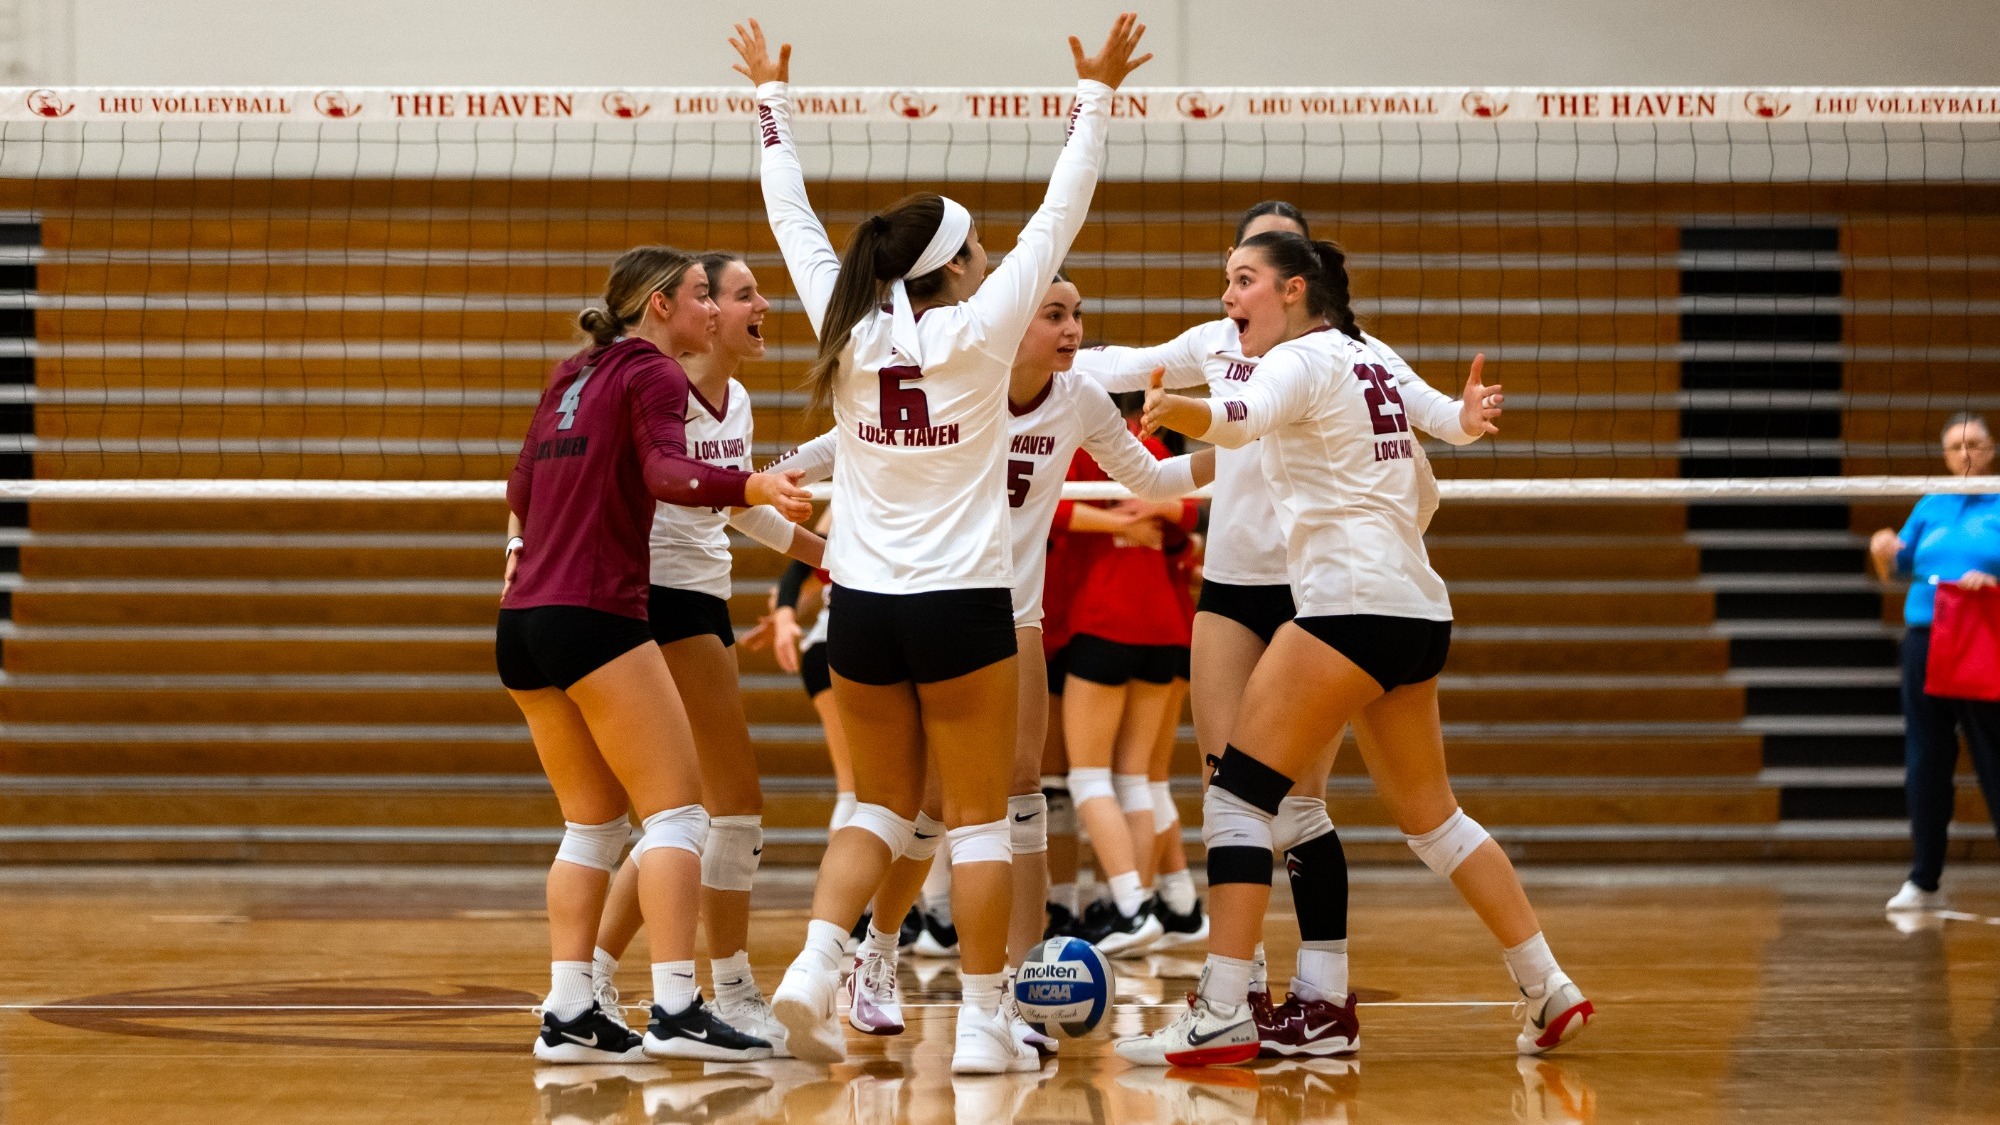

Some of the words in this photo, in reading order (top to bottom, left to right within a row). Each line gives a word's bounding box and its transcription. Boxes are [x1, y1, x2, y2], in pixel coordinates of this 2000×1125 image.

[99, 96, 143, 113] LHU
[152, 96, 291, 113] VOLLEYBALL
[391, 94, 455, 117] THE
[466, 93, 573, 117] HAVEN
[674, 97, 718, 114] LHU
[727, 97, 866, 114] VOYBALL
[965, 94, 1029, 117] THE
[1041, 94, 1148, 118] HEN
[1248, 97, 1292, 115] LHU
[1300, 97, 1438, 114] VOLLEYBALL
[1536, 93, 1599, 117] THE
[1610, 93, 1716, 117] HAVEN
[1814, 96, 1859, 114] LHU
[1865, 96, 2000, 114] VOLLEYBALL
[555, 365, 596, 431] 4
[878, 365, 931, 431] 6
[1353, 363, 1409, 435] 25
[858, 422, 898, 446] LOCK
[904, 423, 960, 446] HAVEN
[1010, 434, 1056, 456] HAVEN
[695, 440, 721, 460] LOCK
[1374, 440, 1400, 462] LOCK
[1007, 459, 1035, 508] 5
[1023, 965, 1077, 979] molten
[1027, 983, 1071, 1001] NCAA
